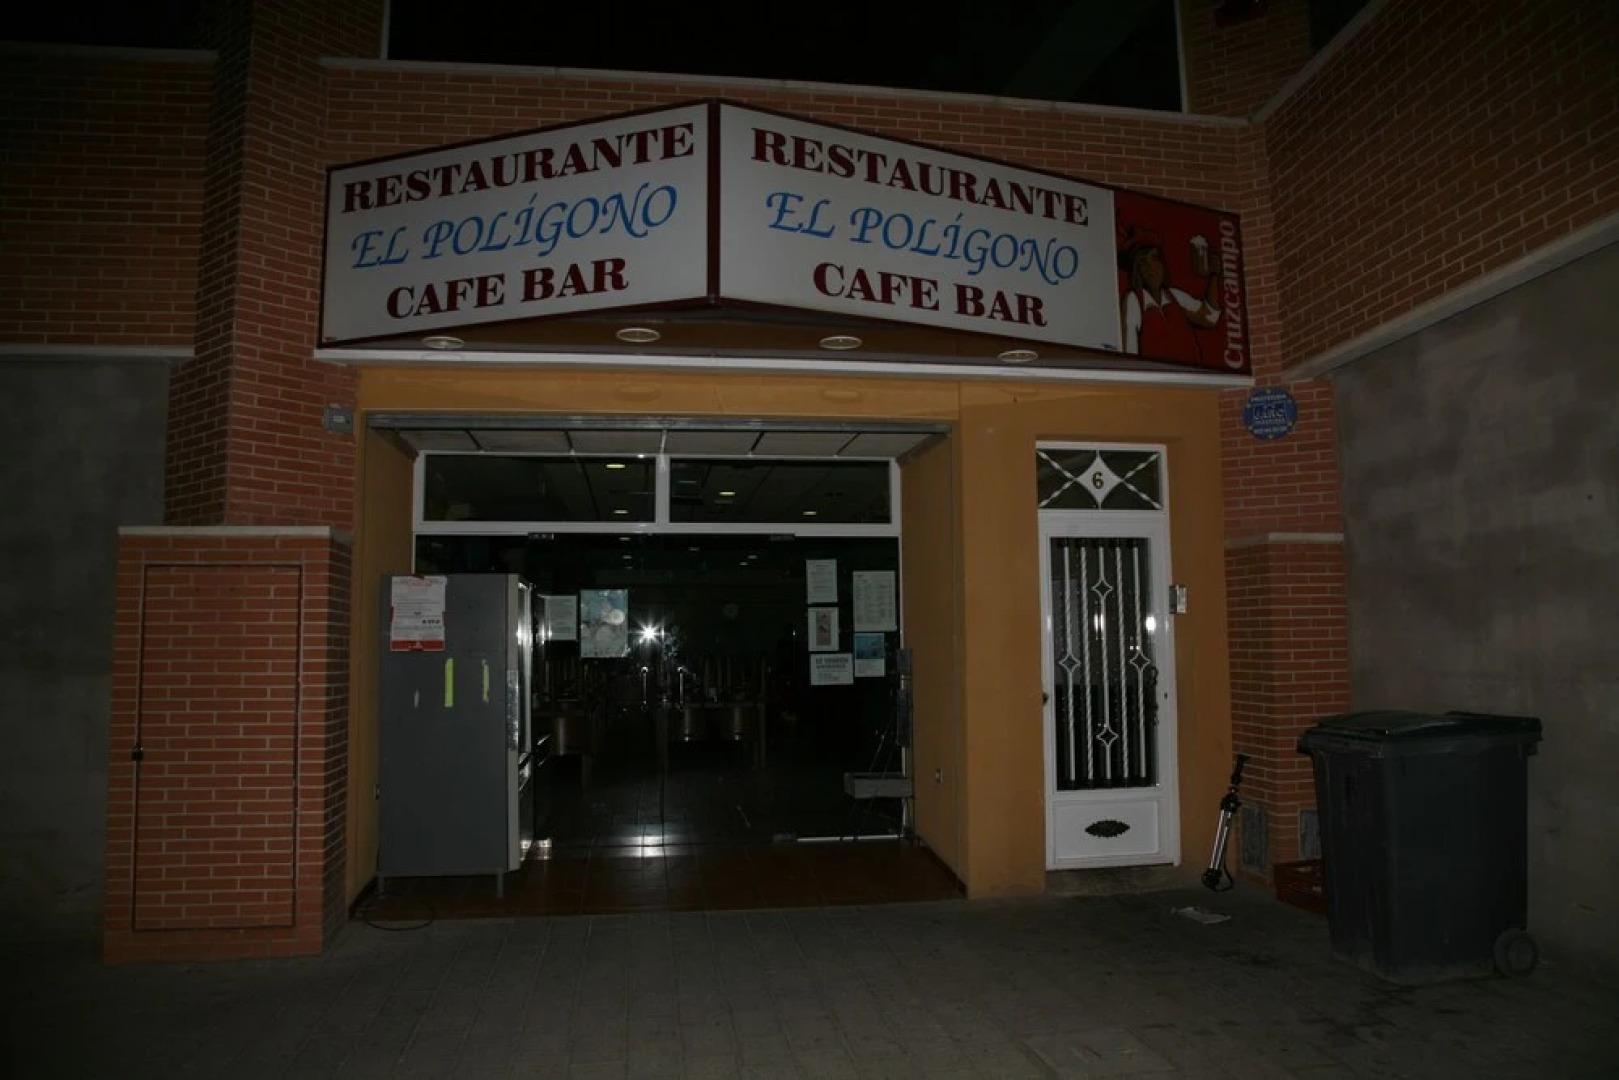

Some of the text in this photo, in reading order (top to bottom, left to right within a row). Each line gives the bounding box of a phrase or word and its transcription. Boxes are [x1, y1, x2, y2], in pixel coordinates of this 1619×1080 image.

[342, 123, 694, 213] RESTAURANTE
[751, 127, 1089, 226] RESTAURANTE
[351, 182, 677, 268] EL POLÍGONO
[766, 192, 1080, 286] EL POLÍGONO
[386, 258, 630, 319] CAFE BAR
[813, 262, 1048, 328] CAFE BAR
[1092, 472, 1104, 490] 6
